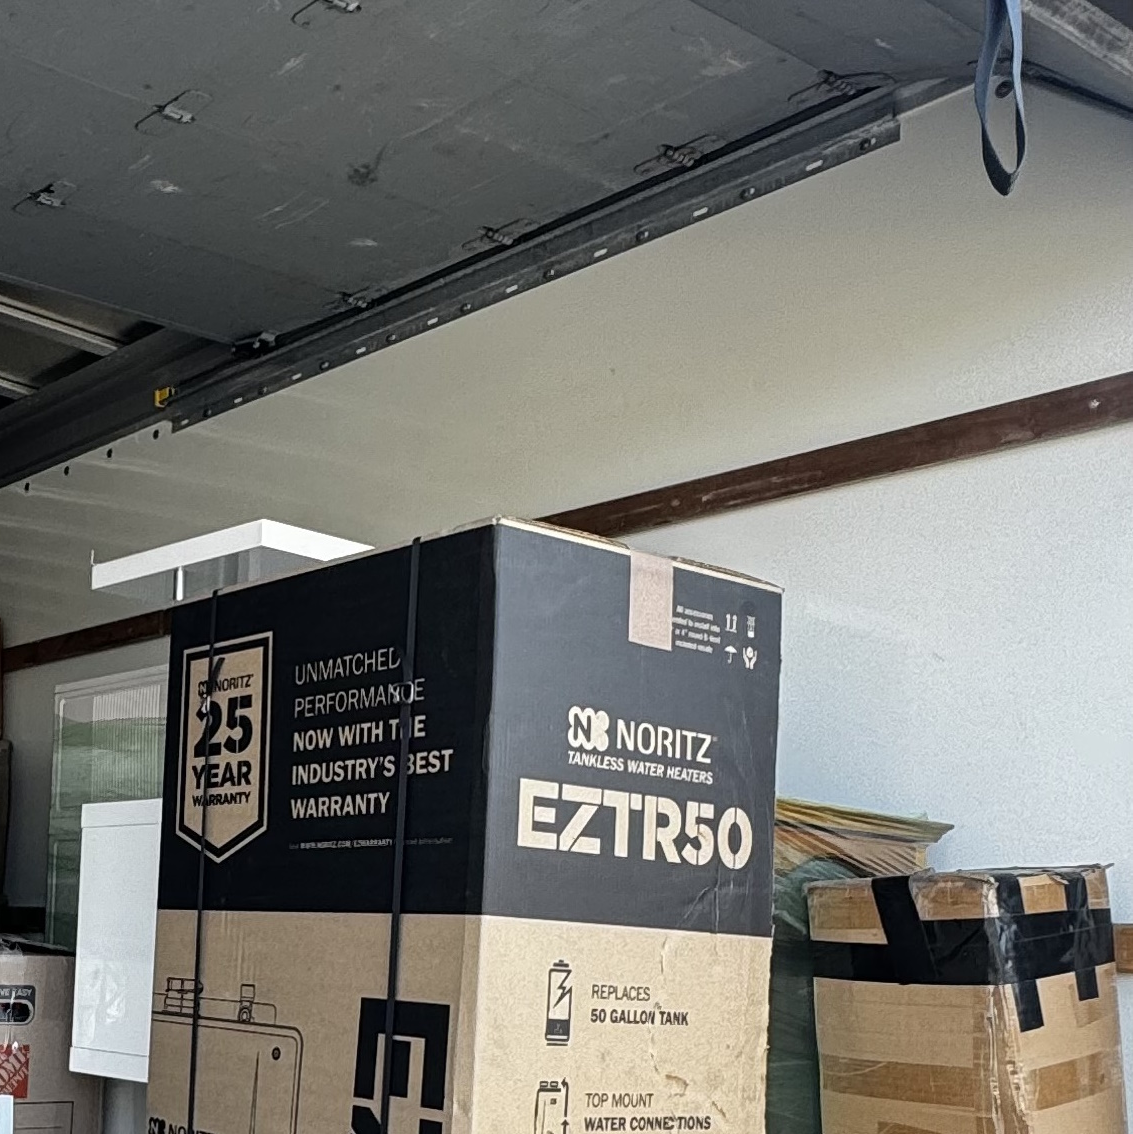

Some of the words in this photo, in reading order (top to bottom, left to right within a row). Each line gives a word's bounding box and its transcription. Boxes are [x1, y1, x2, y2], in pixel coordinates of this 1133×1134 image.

[295, 647, 401, 686] UNMATCHED
[194, 694, 253, 758] 25
[293, 727, 334, 753] NOW
[338, 719, 384, 749] WITH
[616, 718, 713, 764] NORITZ
[191, 760, 252, 790] YEAR
[291, 754, 396, 786] INDUSTRY'S
[406, 748, 455, 776] BEST
[567, 750, 624, 772] TANKLESS
[627, 758, 664, 779] WATER
[667, 764, 714, 785] HEATERS
[192, 791, 252, 808] WARRANTY
[291, 791, 391, 820] WARRANTY
[517, 777, 753, 870] EZTR50
[591, 984, 651, 1002] REPLACES
[590, 1008, 607, 1024] 50
[609, 1009, 655, 1025] GALLON
[658, 1010, 689, 1026] TANK
[585, 1092, 609, 1107] TOP
[611, 1092, 654, 1107] MOUNT
[584, 1116, 626, 1132] WATER
[629, 1115, 712, 1131] CONNECTIONS
